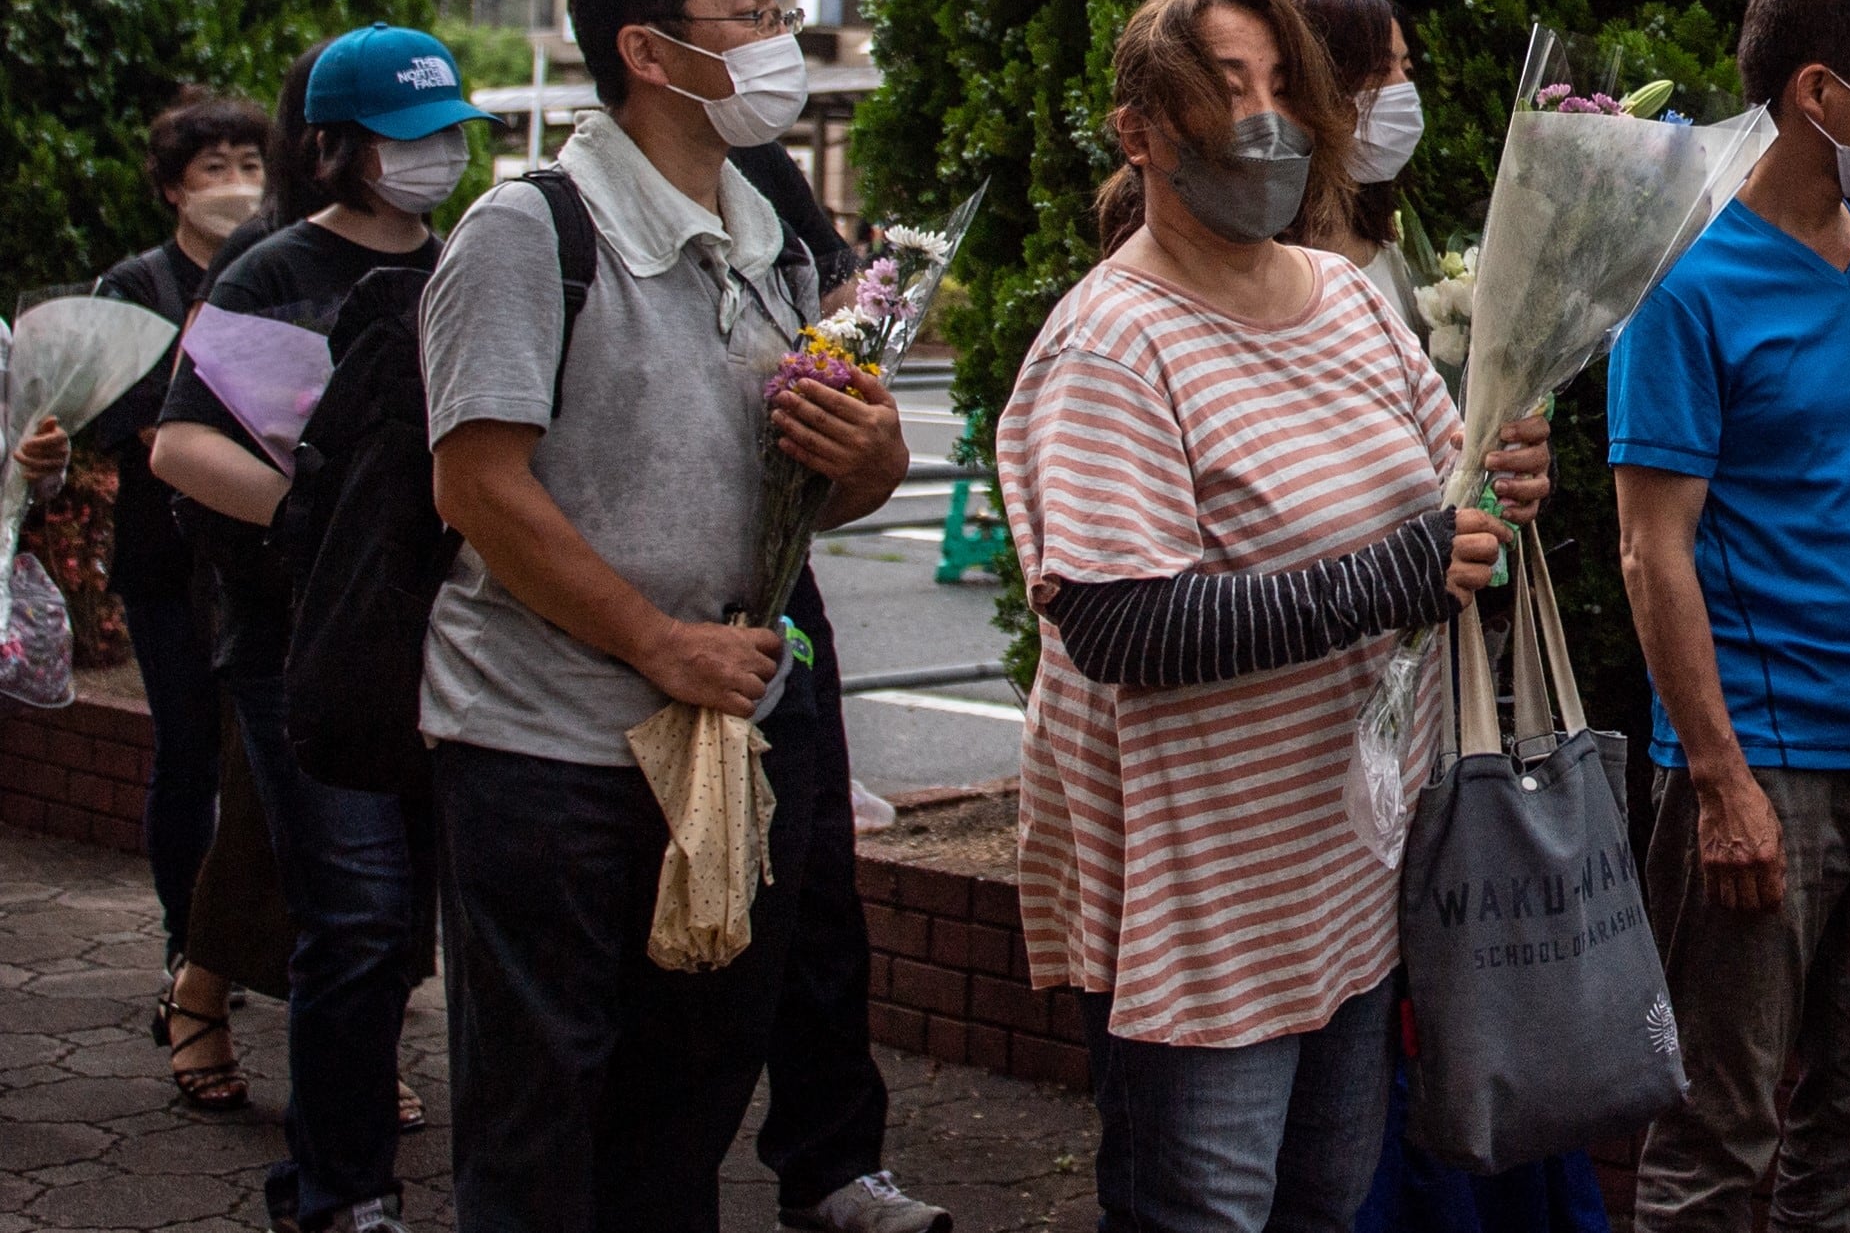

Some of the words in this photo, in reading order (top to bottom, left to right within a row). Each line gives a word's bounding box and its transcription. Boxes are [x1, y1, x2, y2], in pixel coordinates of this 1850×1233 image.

[411, 56, 439, 70] THE
[396, 67, 441, 84] NORTH
[413, 78, 446, 91] FACE
[1473, 940, 1566, 970] SCHOOL
